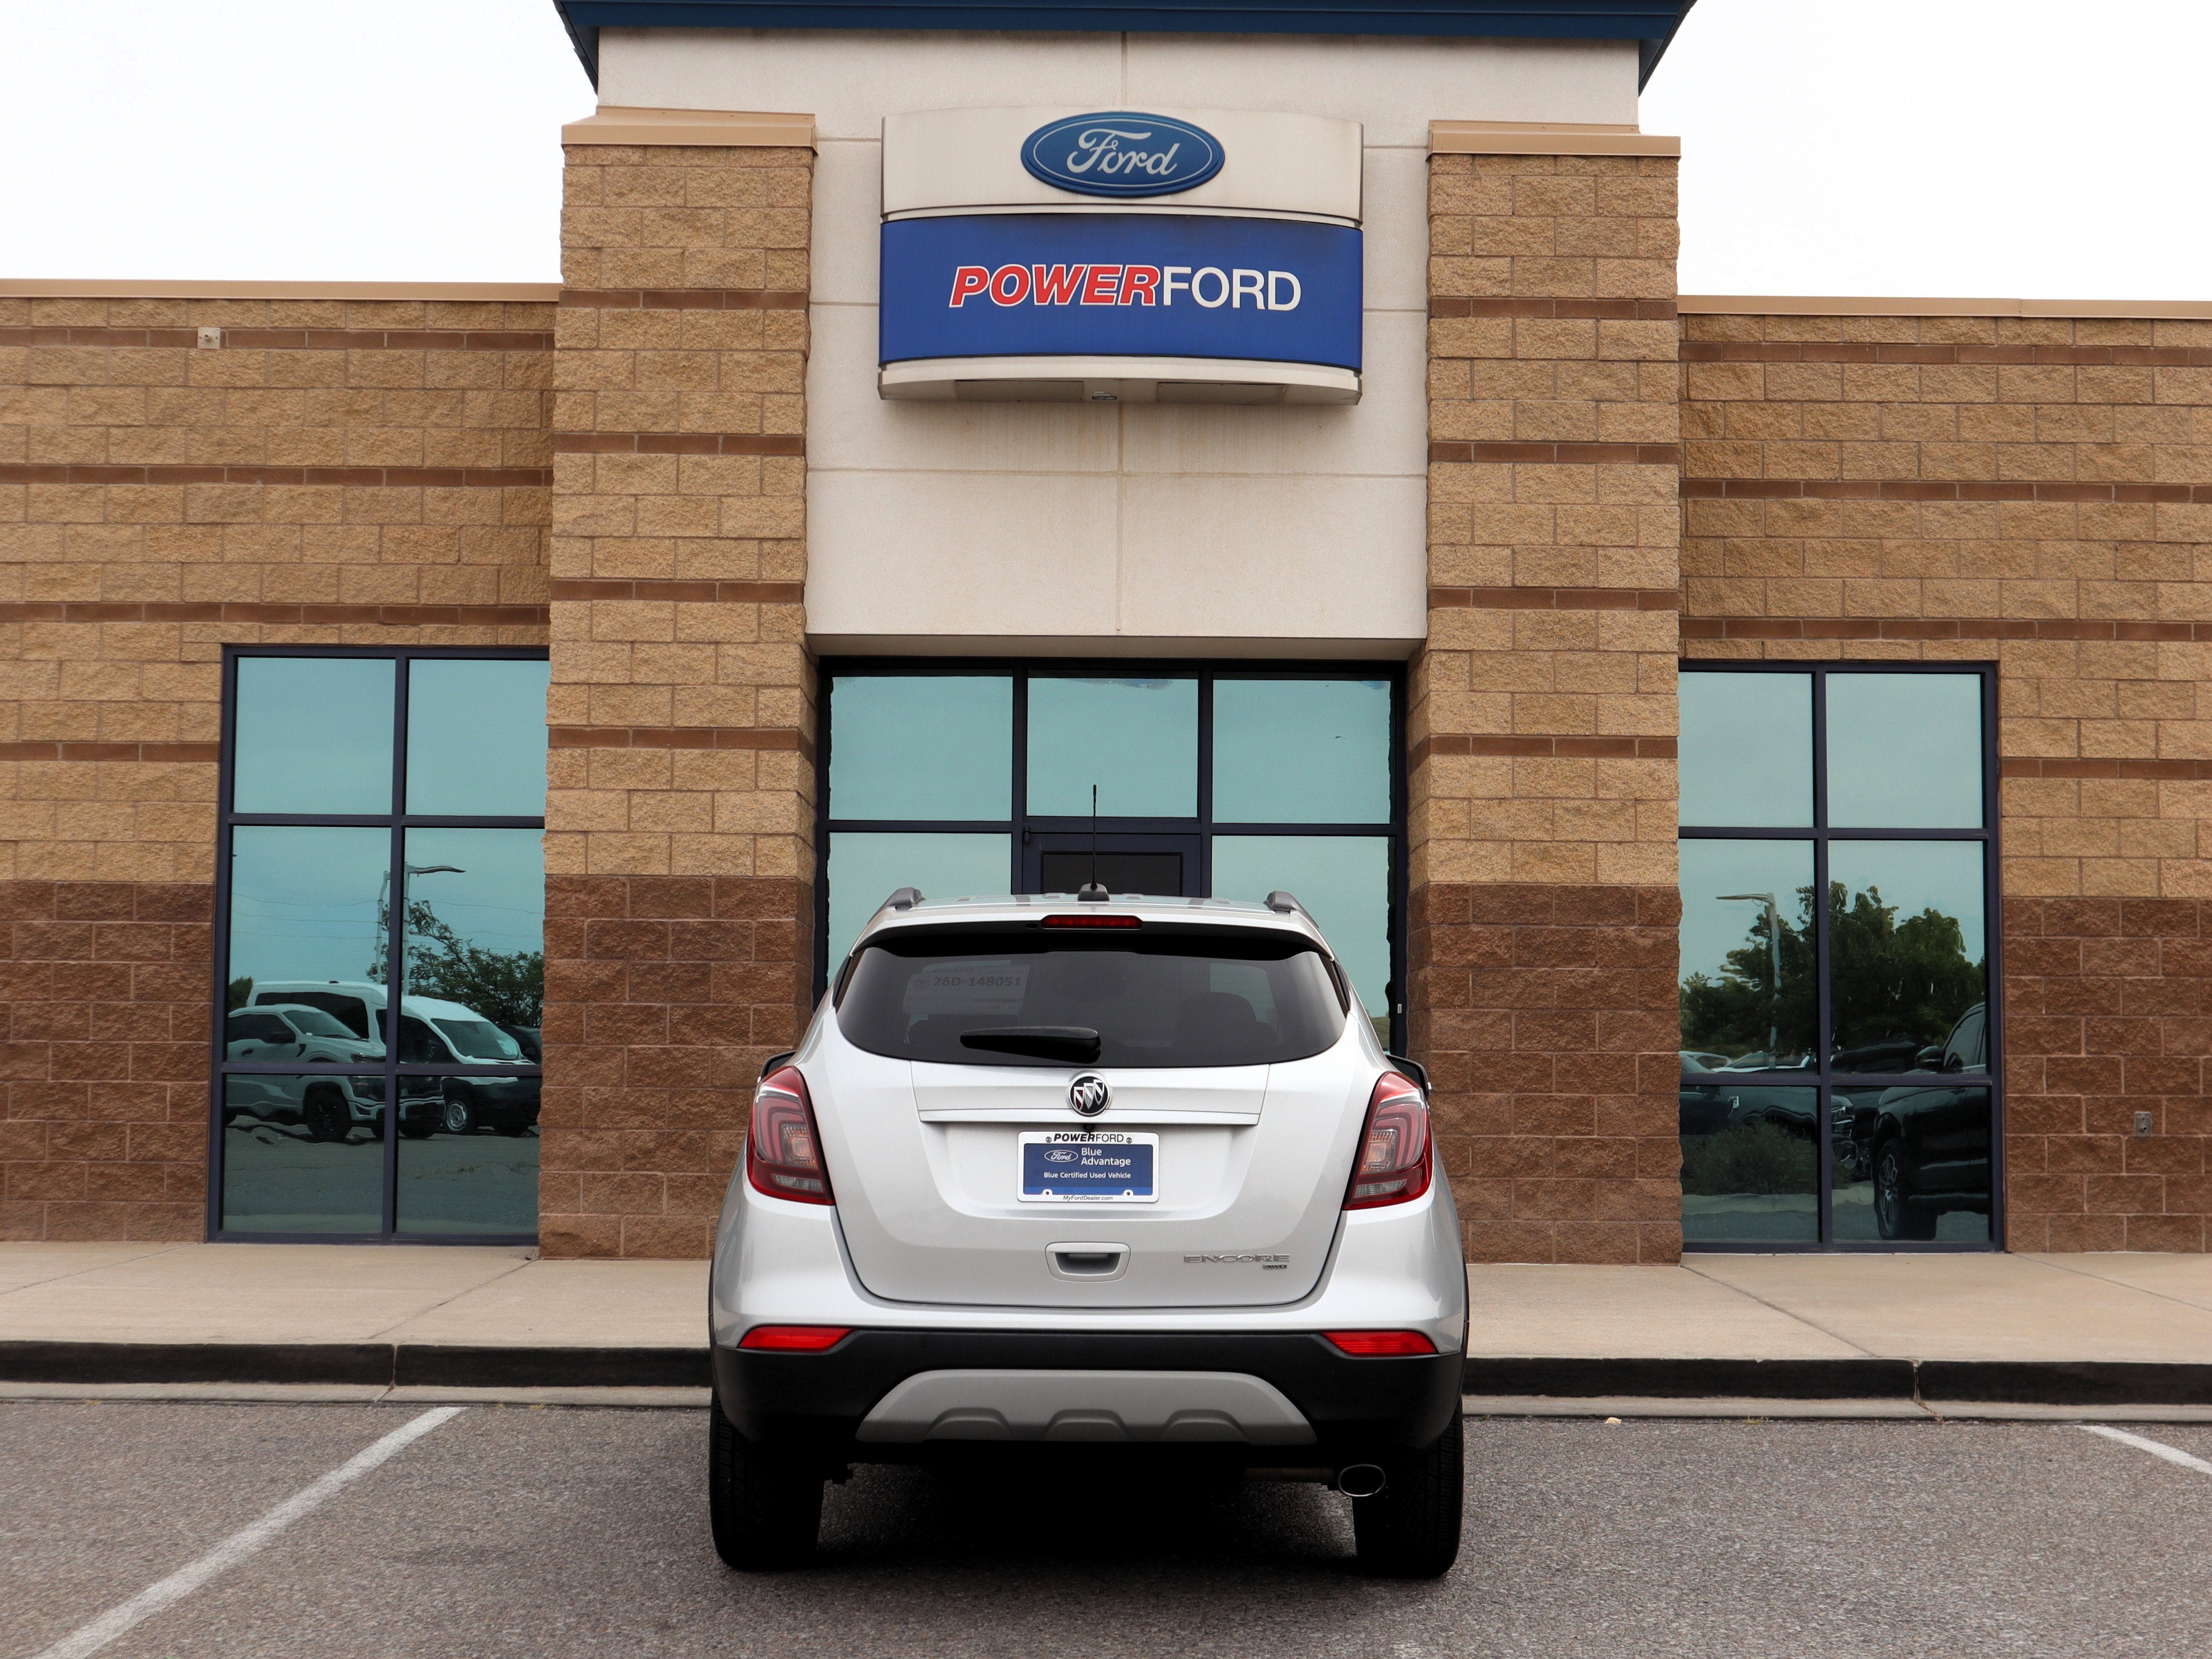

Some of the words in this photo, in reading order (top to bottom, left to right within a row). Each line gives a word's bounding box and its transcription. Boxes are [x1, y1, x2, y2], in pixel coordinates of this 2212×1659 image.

[1067, 128, 1180, 175] Ford
[933, 976, 1021, 986] 26D-148051
[1051, 1151, 1072, 1161] Ford
[1081, 1147, 1102, 1156] Blue
[1081, 1157, 1131, 1167] Advantage
[1184, 1254, 1290, 1263] ENCORE
